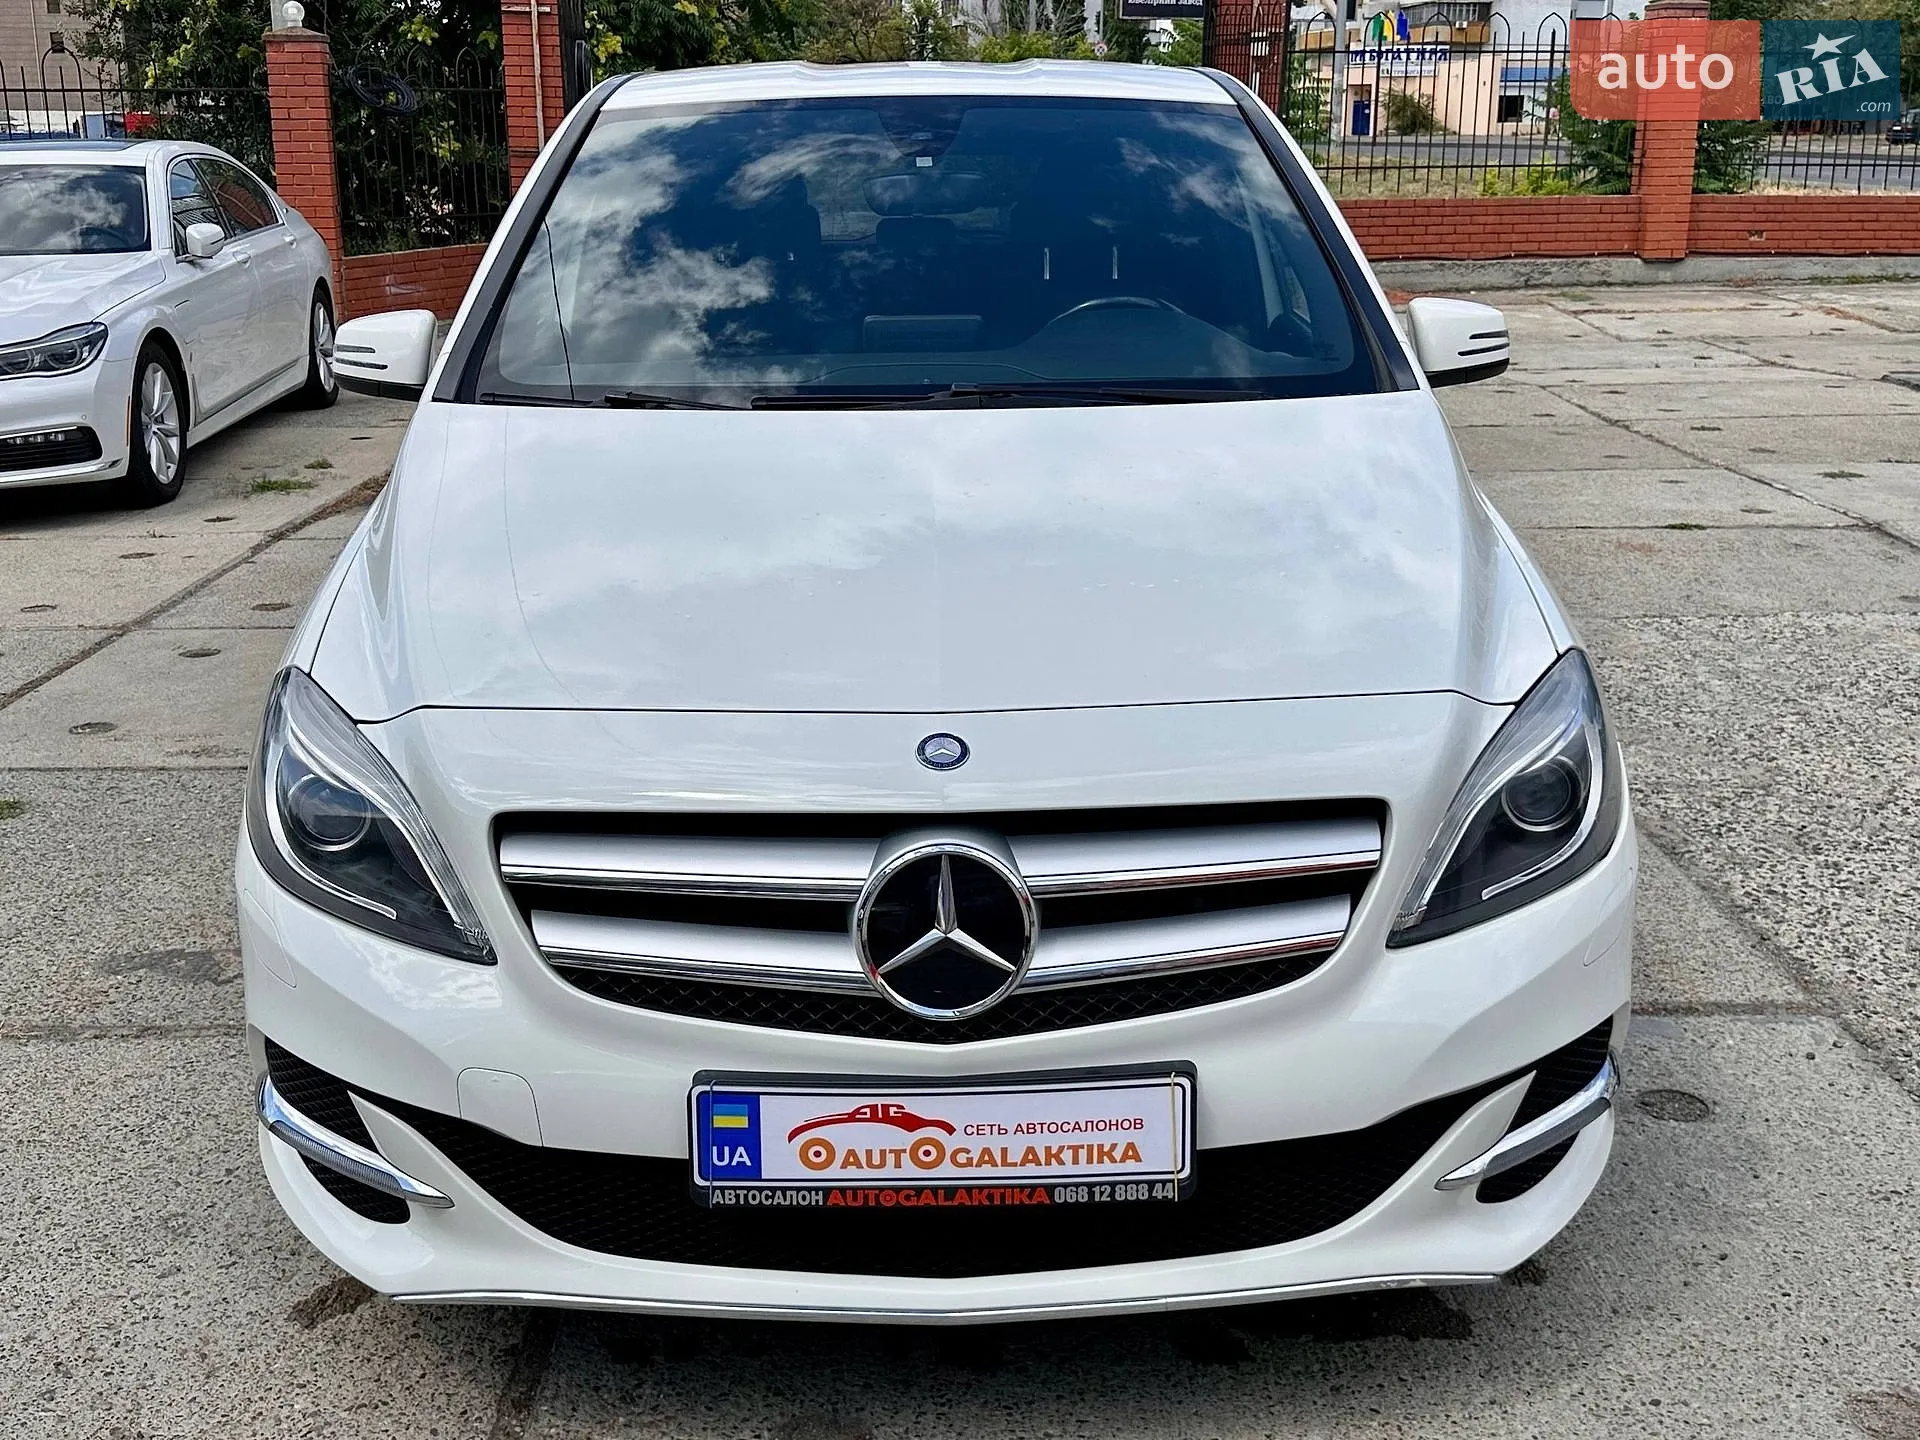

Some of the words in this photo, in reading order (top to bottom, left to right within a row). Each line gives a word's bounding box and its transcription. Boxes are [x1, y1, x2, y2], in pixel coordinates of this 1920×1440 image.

[963, 1123, 1008, 1136] СЕТЬ
[1013, 1117, 1144, 1136] АВТОСАЛОНОВ
[712, 1145, 752, 1166] UA
[711, 1189, 824, 1206] АВТОСАЛОН
[827, 1187, 1051, 1206] AUTOGALAKTIKA
[1054, 1186, 1088, 1203] 068
[1092, 1185, 1111, 1201] 12
[1115, 1183, 1149, 1201] 888
[1152, 1182, 1174, 1199] 44
